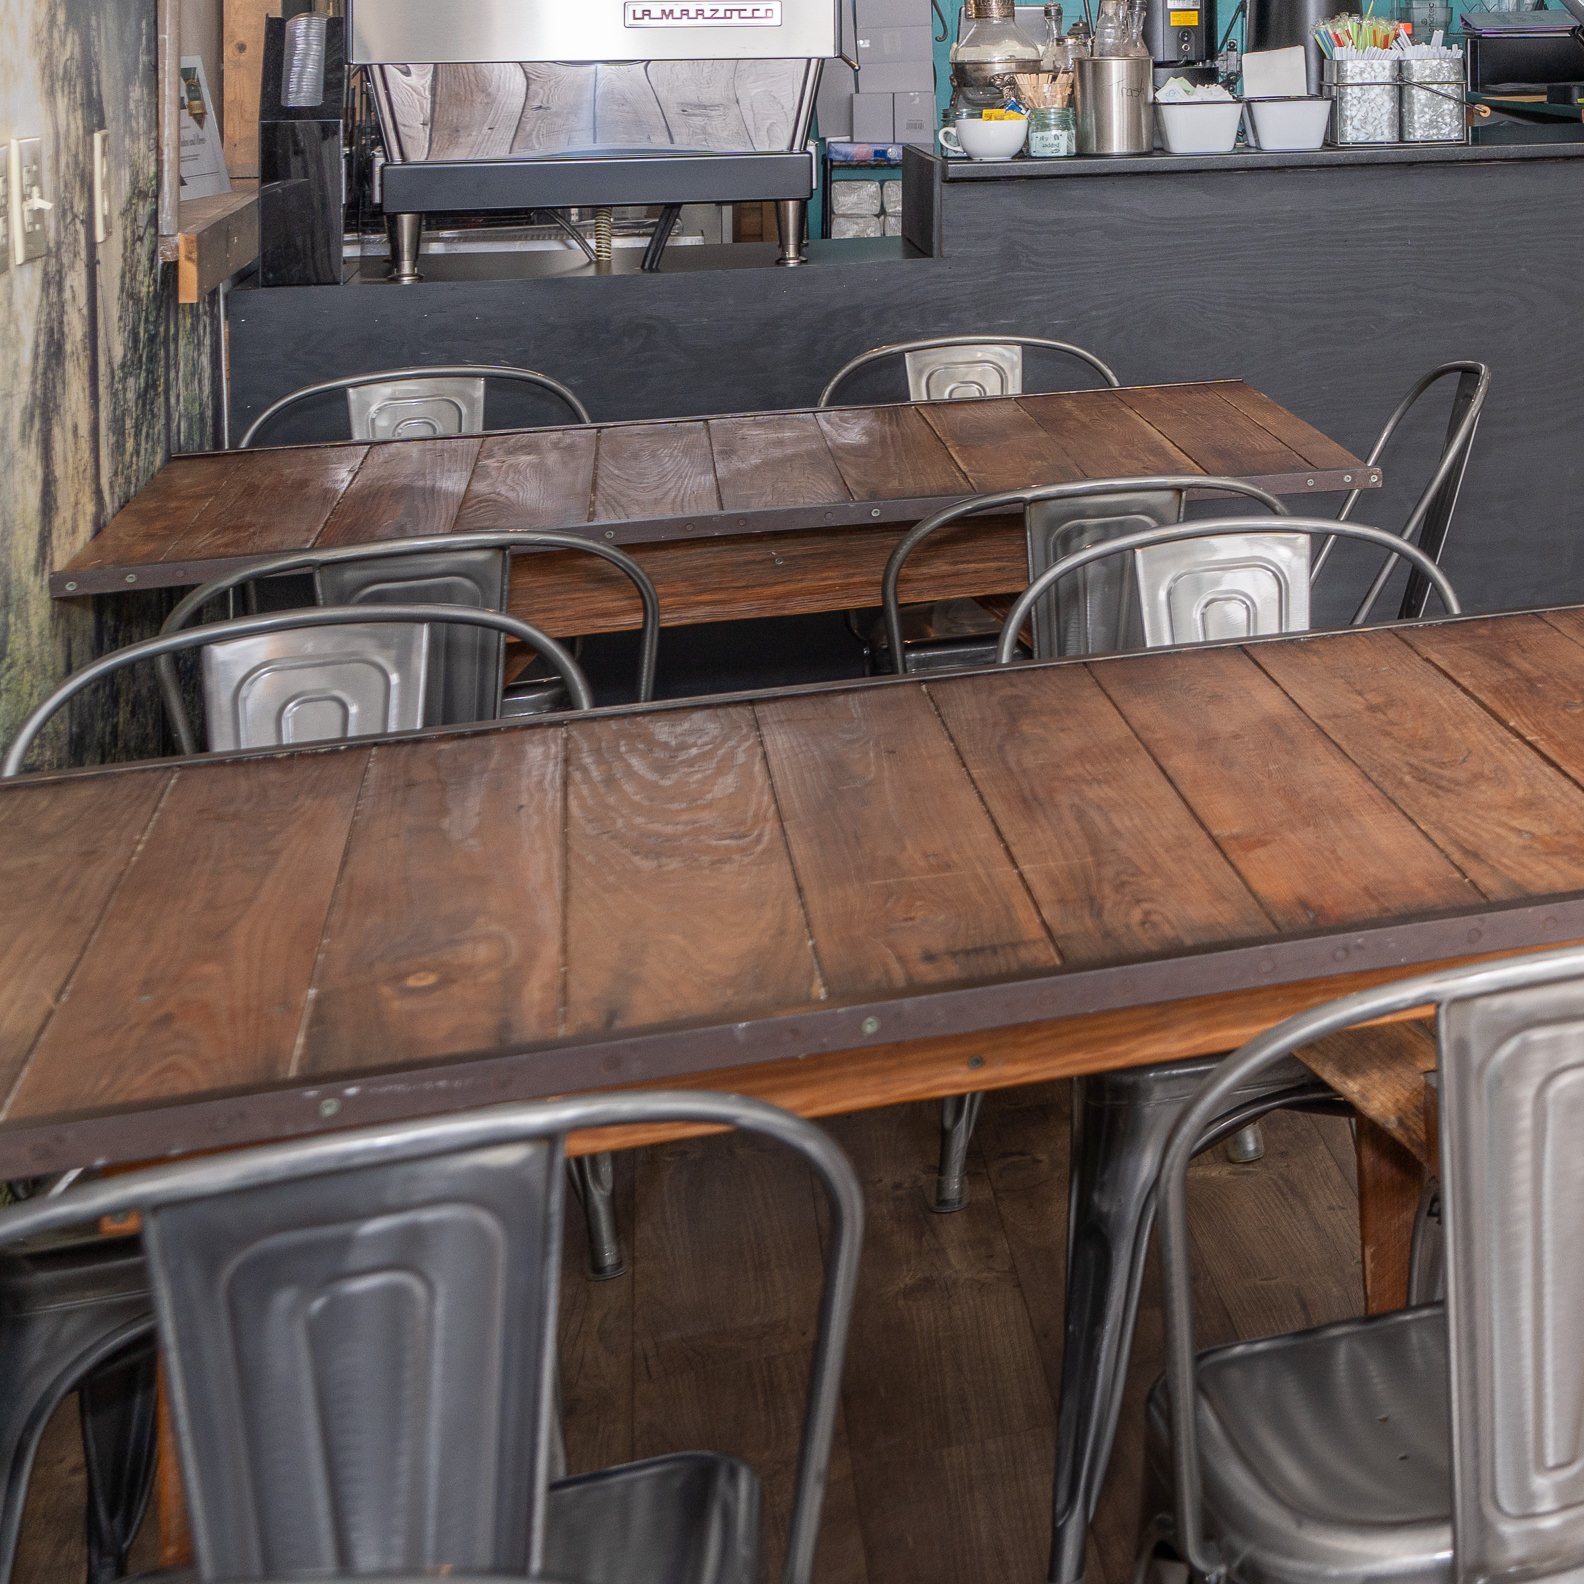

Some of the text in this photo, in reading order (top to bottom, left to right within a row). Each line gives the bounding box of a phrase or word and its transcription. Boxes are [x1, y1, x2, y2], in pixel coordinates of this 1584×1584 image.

[632, 8, 774, 21] LA MARZOCCO
[1106, 79, 1145, 99] Trash
